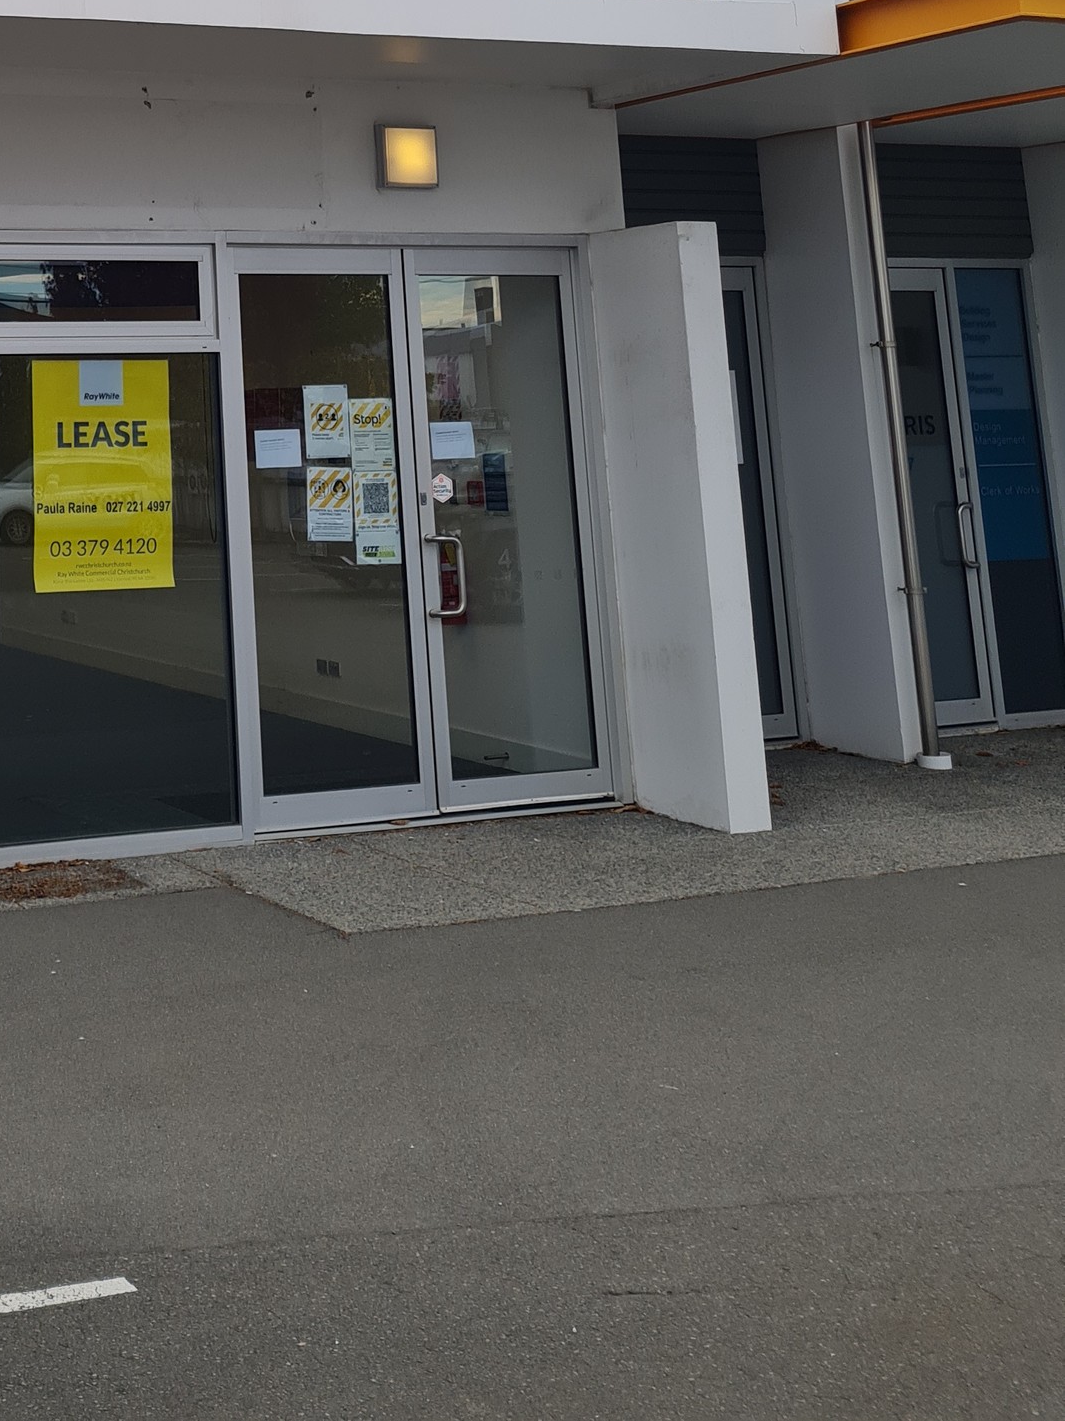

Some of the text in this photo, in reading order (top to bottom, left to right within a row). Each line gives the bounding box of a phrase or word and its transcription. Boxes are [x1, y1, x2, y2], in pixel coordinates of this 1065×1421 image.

[353, 413, 381, 426] Stop!
[973, 422, 1001, 433] Design
[56, 420, 149, 448] LEASE
[974, 435, 1026, 447] Management
[981, 486, 1001, 496] Clerk
[36, 500, 171, 514] Paula Raine 027 221 4997
[49, 537, 157, 557] 03 379 4120
[117, 568, 151, 576] Christchurch
